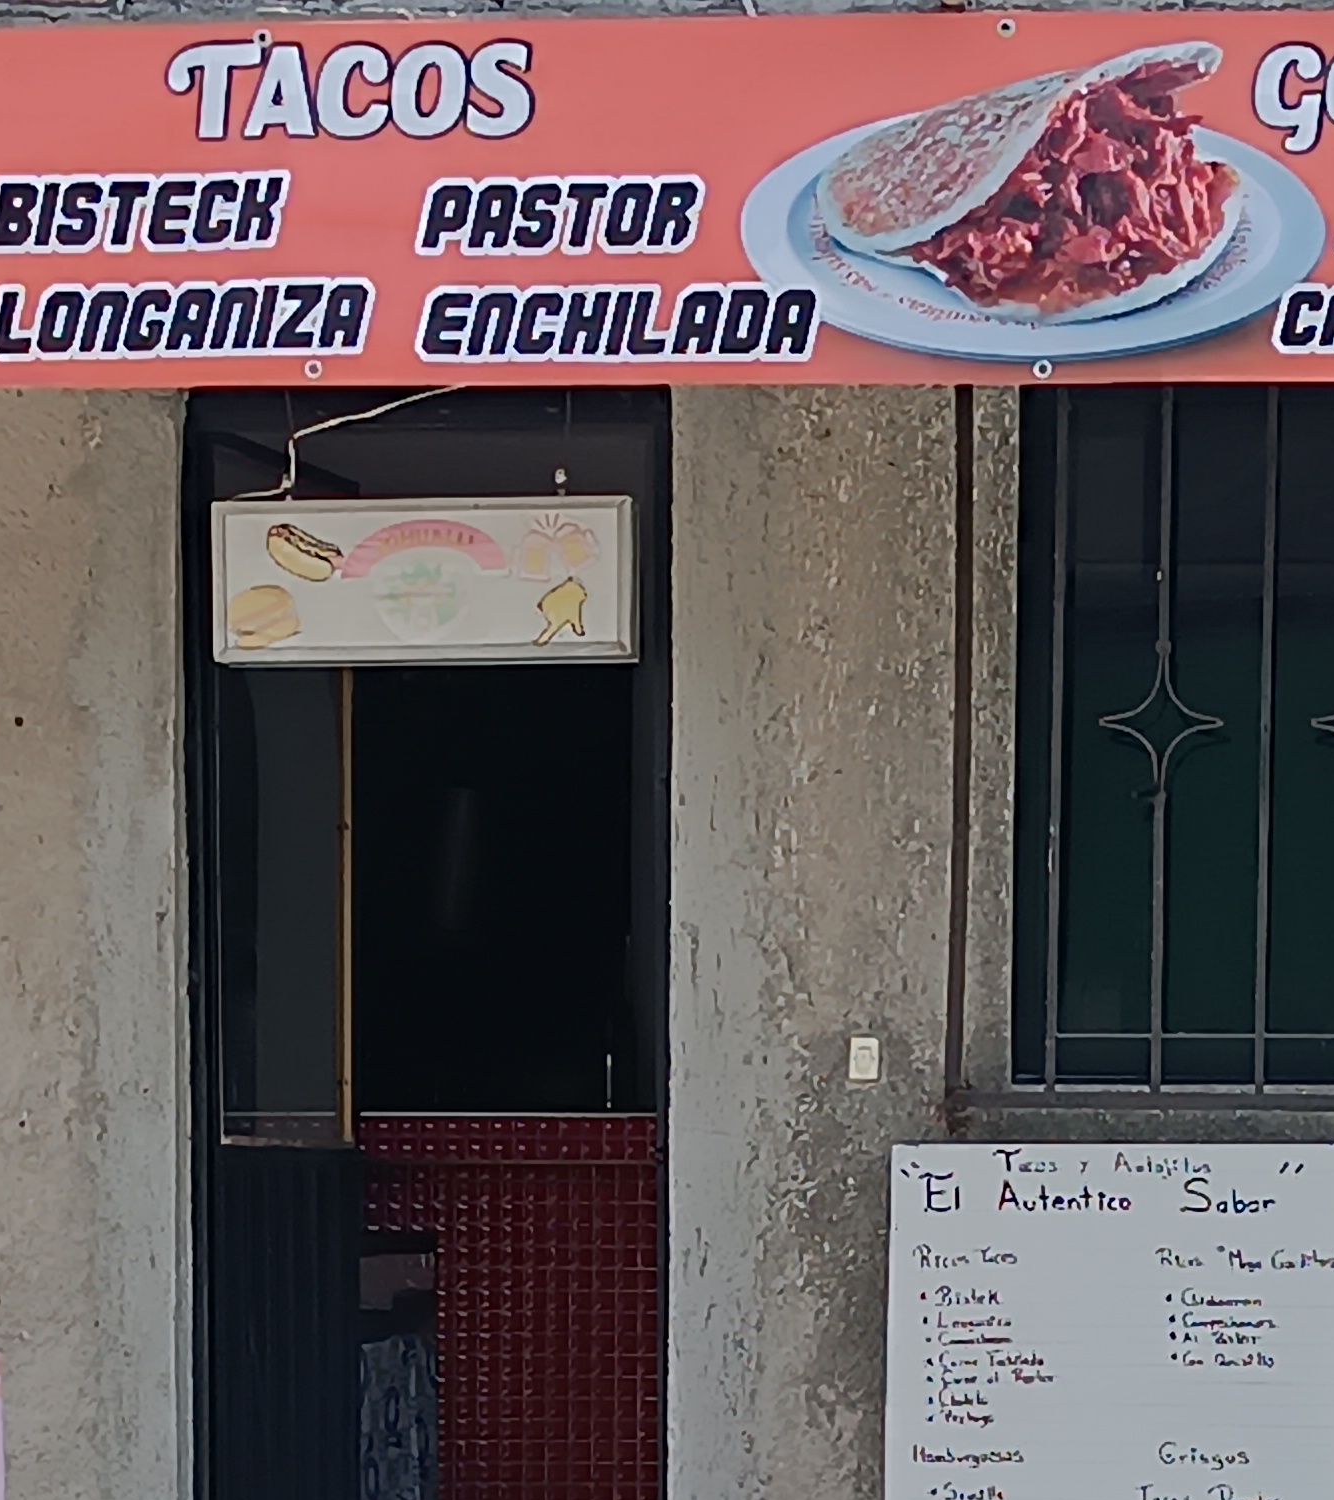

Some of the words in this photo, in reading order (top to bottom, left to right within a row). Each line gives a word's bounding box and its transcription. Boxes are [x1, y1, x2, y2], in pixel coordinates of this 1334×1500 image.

[166, 38, 535, 141] TACOS
[417, 176, 701, 255] PASTOR
[419, 282, 821, 361] ENCHILADA
